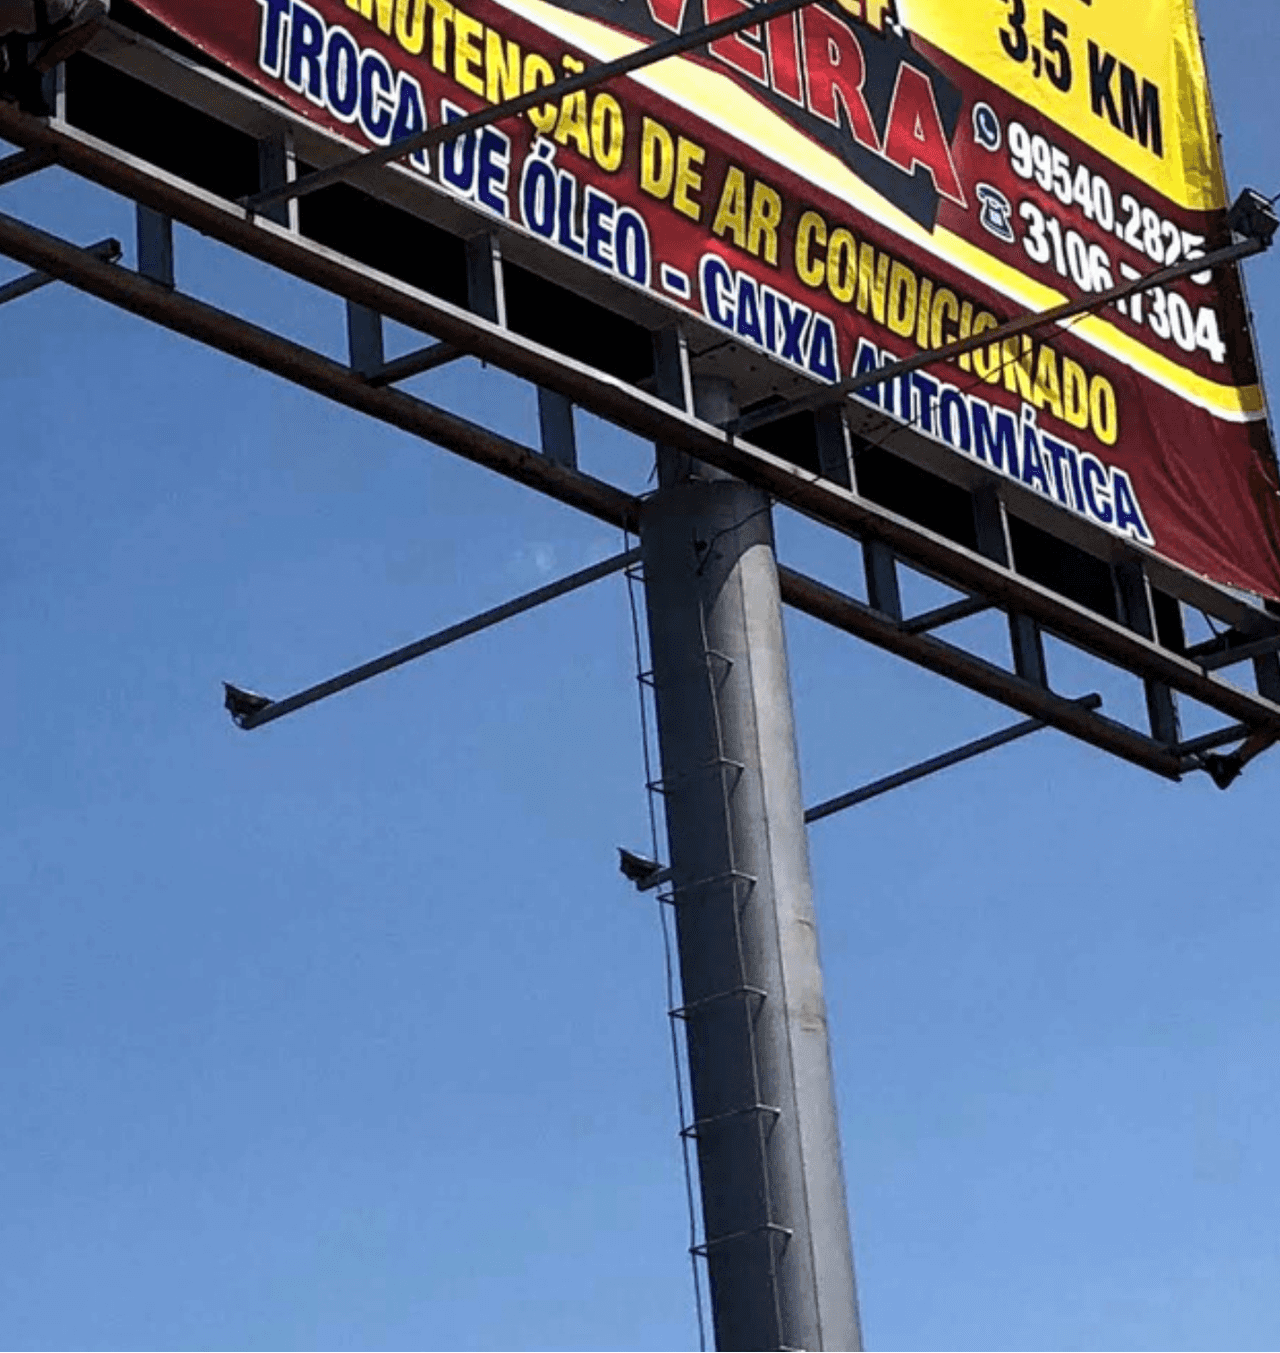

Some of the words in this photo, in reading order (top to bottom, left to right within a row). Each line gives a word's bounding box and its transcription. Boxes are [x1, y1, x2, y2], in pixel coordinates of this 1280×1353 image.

[1008, 121, 1213, 285] 99540.2825
[1087, 38, 1164, 159] KM
[440, 98, 510, 219] DE
[520, 137, 651, 289] ÓLEO
[700, 255, 842, 384] CAIXA
[641, 115, 706, 222] DE
[712, 166, 782, 267] AR
[795, 210, 1118, 445] CONDICIONADO
